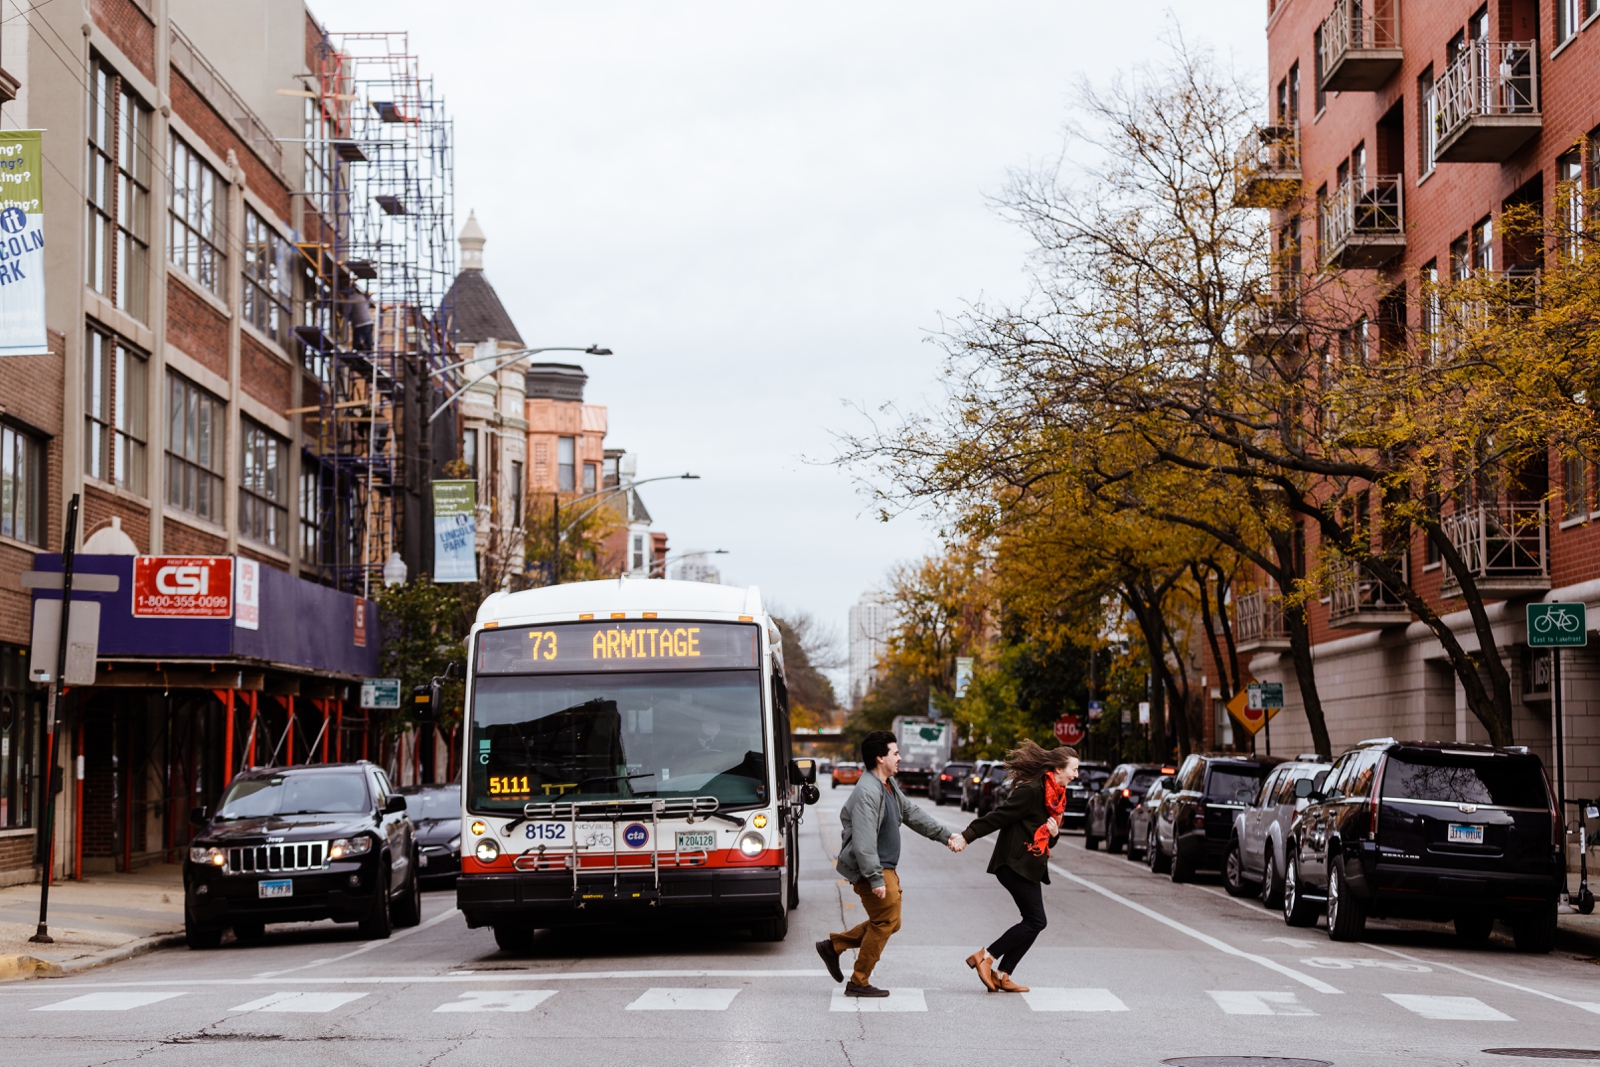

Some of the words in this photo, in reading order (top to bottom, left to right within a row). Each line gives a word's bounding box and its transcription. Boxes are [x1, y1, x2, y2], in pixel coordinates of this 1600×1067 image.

[0, 172, 31, 184] ing?
[3, 210, 23, 233] it
[439, 523, 476, 543] LINCOLN
[443, 537, 467, 553] PARK
[155, 565, 209, 595] CSI
[137, 595, 228, 607] 1-800-355-0099
[528, 631, 558, 660] 73
[592, 627, 701, 659] ARMITAGE
[1555, 635, 1581, 643] Lakefront
[479, 753, 490, 765] C
[489, 776, 531, 794] 5111
[525, 823, 566, 839] 8152
[627, 831, 645, 841] cta
[679, 836, 684, 846] M
[685, 835, 714, 846] 204128
